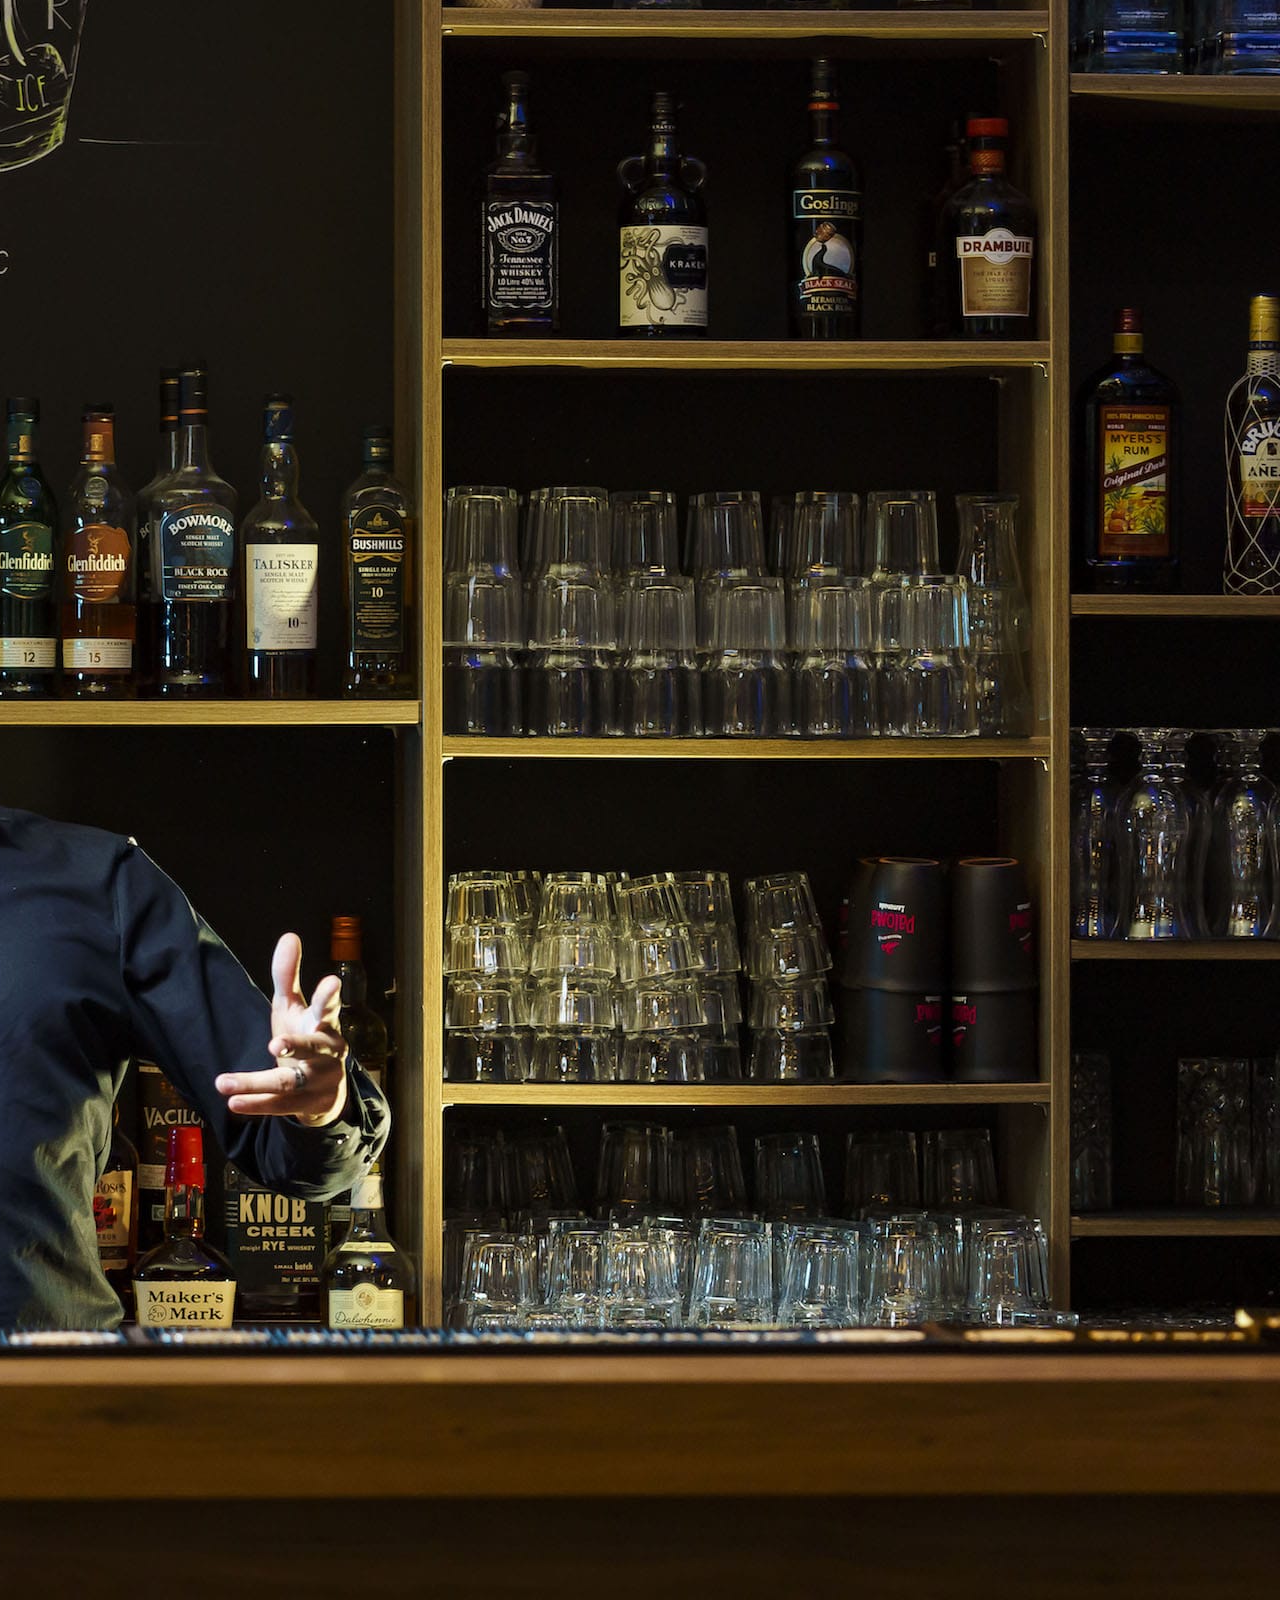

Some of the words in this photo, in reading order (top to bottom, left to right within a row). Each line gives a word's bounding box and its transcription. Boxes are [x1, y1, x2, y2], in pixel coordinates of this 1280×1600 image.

[16, 73, 51, 112] ICE
[799, 194, 858, 216] Goslings
[487, 211, 514, 233] JACK
[514, 206, 554, 233] DANIEL'S
[963, 241, 1031, 253] DRAMBUIE
[499, 253, 544, 264] Tennessee
[500, 268, 543, 277] WHISKEY
[805, 280, 833, 289] BLACK
[1242, 421, 1280, 453] BRU
[1123, 446, 1150, 455] RUM
[1248, 463, 1280, 477] AÑE
[1103, 465, 1145, 488] Original
[168, 514, 234, 536] BOWMORE
[353, 539, 403, 550] BUSHMILLS
[67, 553, 126, 572] Glenfiddich
[253, 558, 313, 570] TALISKER
[174, 568, 204, 577] BLACK
[206, 568, 228, 577] ROCK
[371, 587, 384, 598] 10
[288, 617, 299, 628] 10
[23, 651, 36, 664] 12
[88, 652, 101, 664] 15
[239, 1193, 307, 1223] KNOB
[246, 1226, 316, 1237] CREEK
[261, 1241, 286, 1251] RYE
[294, 1262, 313, 1271] batch
[148, 1290, 224, 1304] Maker's
[170, 1307, 224, 1320] Mark
